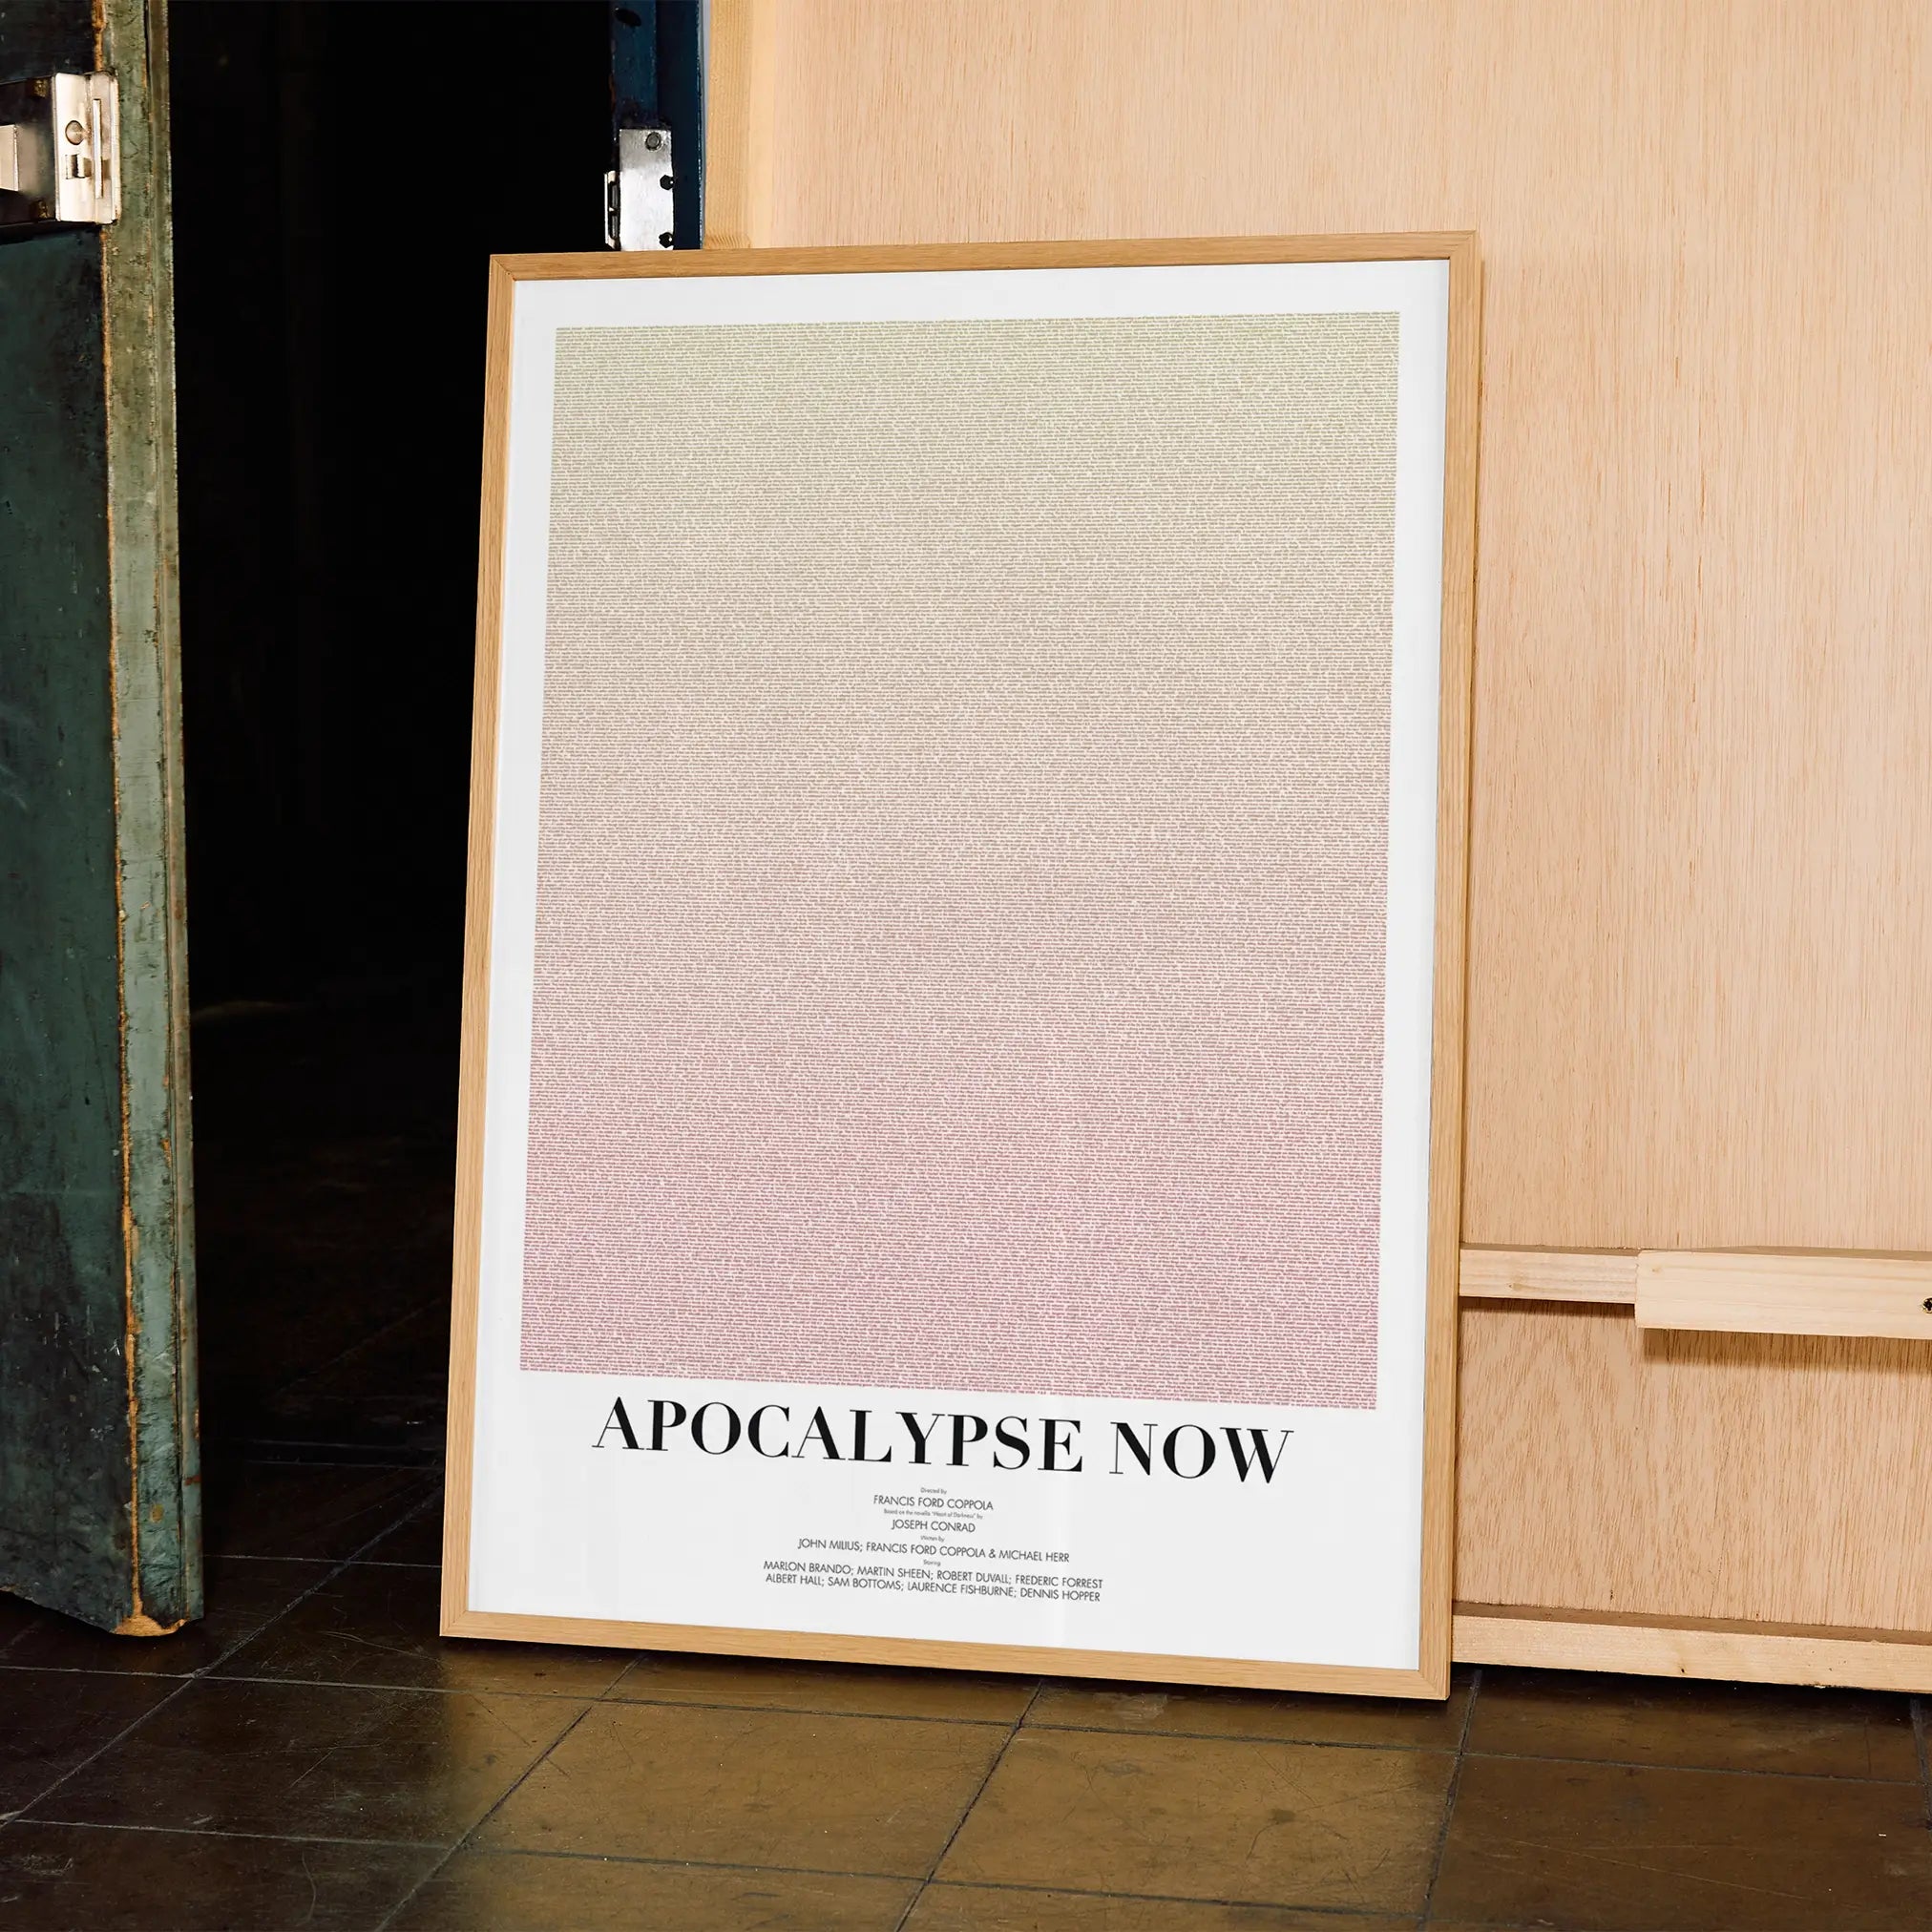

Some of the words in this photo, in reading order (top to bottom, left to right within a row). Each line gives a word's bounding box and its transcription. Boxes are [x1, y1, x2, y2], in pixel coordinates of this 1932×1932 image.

[592, 1396, 1082, 1472] APOCALYPSE
[1109, 1422, 1294, 1483] NOW
[873, 1495, 915, 1507] FRANCIS
[917, 1497, 944, 1508] FORD
[947, 1499, 994, 1510] COPPOLA
[892, 1519, 928, 1531] JOSEPH
[931, 1522, 976, 1532] CONRAD
[797, 1539, 827, 1549] JOHN
[830, 1540, 863, 1552] MILIUS;
[866, 1542, 908, 1553] FRANCIS
[911, 1544, 937, 1555] FORD
[939, 1546, 986, 1558] COPPOLA
[989, 1548, 996, 1559] &
[998, 1550, 1043, 1561] MICHAEL
[1045, 1552, 1070, 1563] HERR
[763, 1561, 807, 1573] MARLON
[808, 1562, 854, 1575] BRANDO;
[857, 1565, 895, 1578] MARTIN
[897, 1567, 934, 1580] SHEEN;
[937, 1570, 973, 1582] ROBERT
[976, 1572, 1012, 1585] DUVALL;
[1015, 1575, 1060, 1586] FREDERIC
[1061, 1578, 1103, 1588] FORREST
[766, 1573, 797, 1585] ALBERT
[800, 1575, 825, 1587] HALL;
[828, 1577, 850, 1587] SAM
[852, 1578, 904, 1591] BOTTOMS;
[907, 1582, 957, 1594] LAURENCE
[960, 1584, 1017, 1598] FISHBURNE;
[1019, 1587, 1059, 1600] DENNIS
[1061, 1590, 1101, 1602] HOPPER
